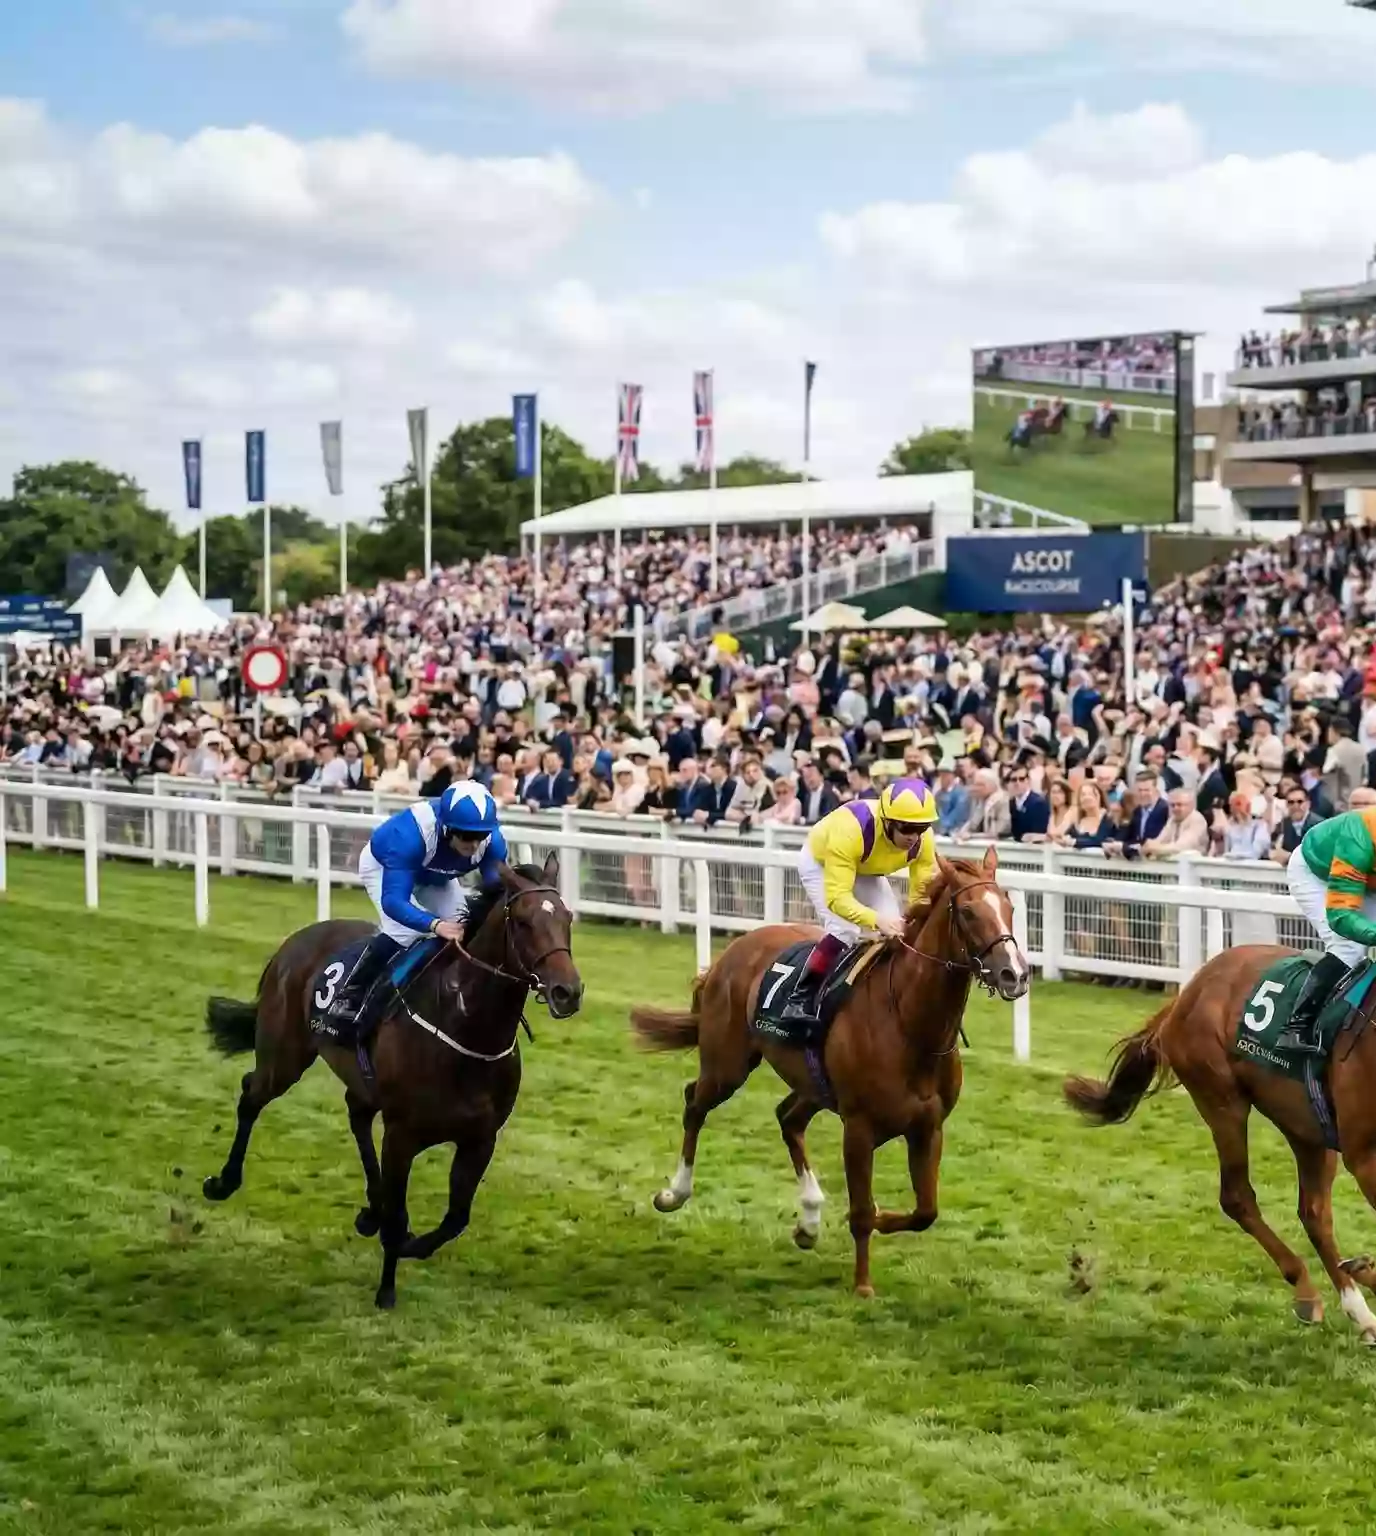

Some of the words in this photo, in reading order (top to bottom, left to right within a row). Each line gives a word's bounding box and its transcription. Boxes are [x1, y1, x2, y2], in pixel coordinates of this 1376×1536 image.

[1012, 550, 1074, 573] ASCOT
[315, 961, 345, 1009] 3
[762, 962, 797, 1009] 7
[1244, 980, 1285, 1032] 5
